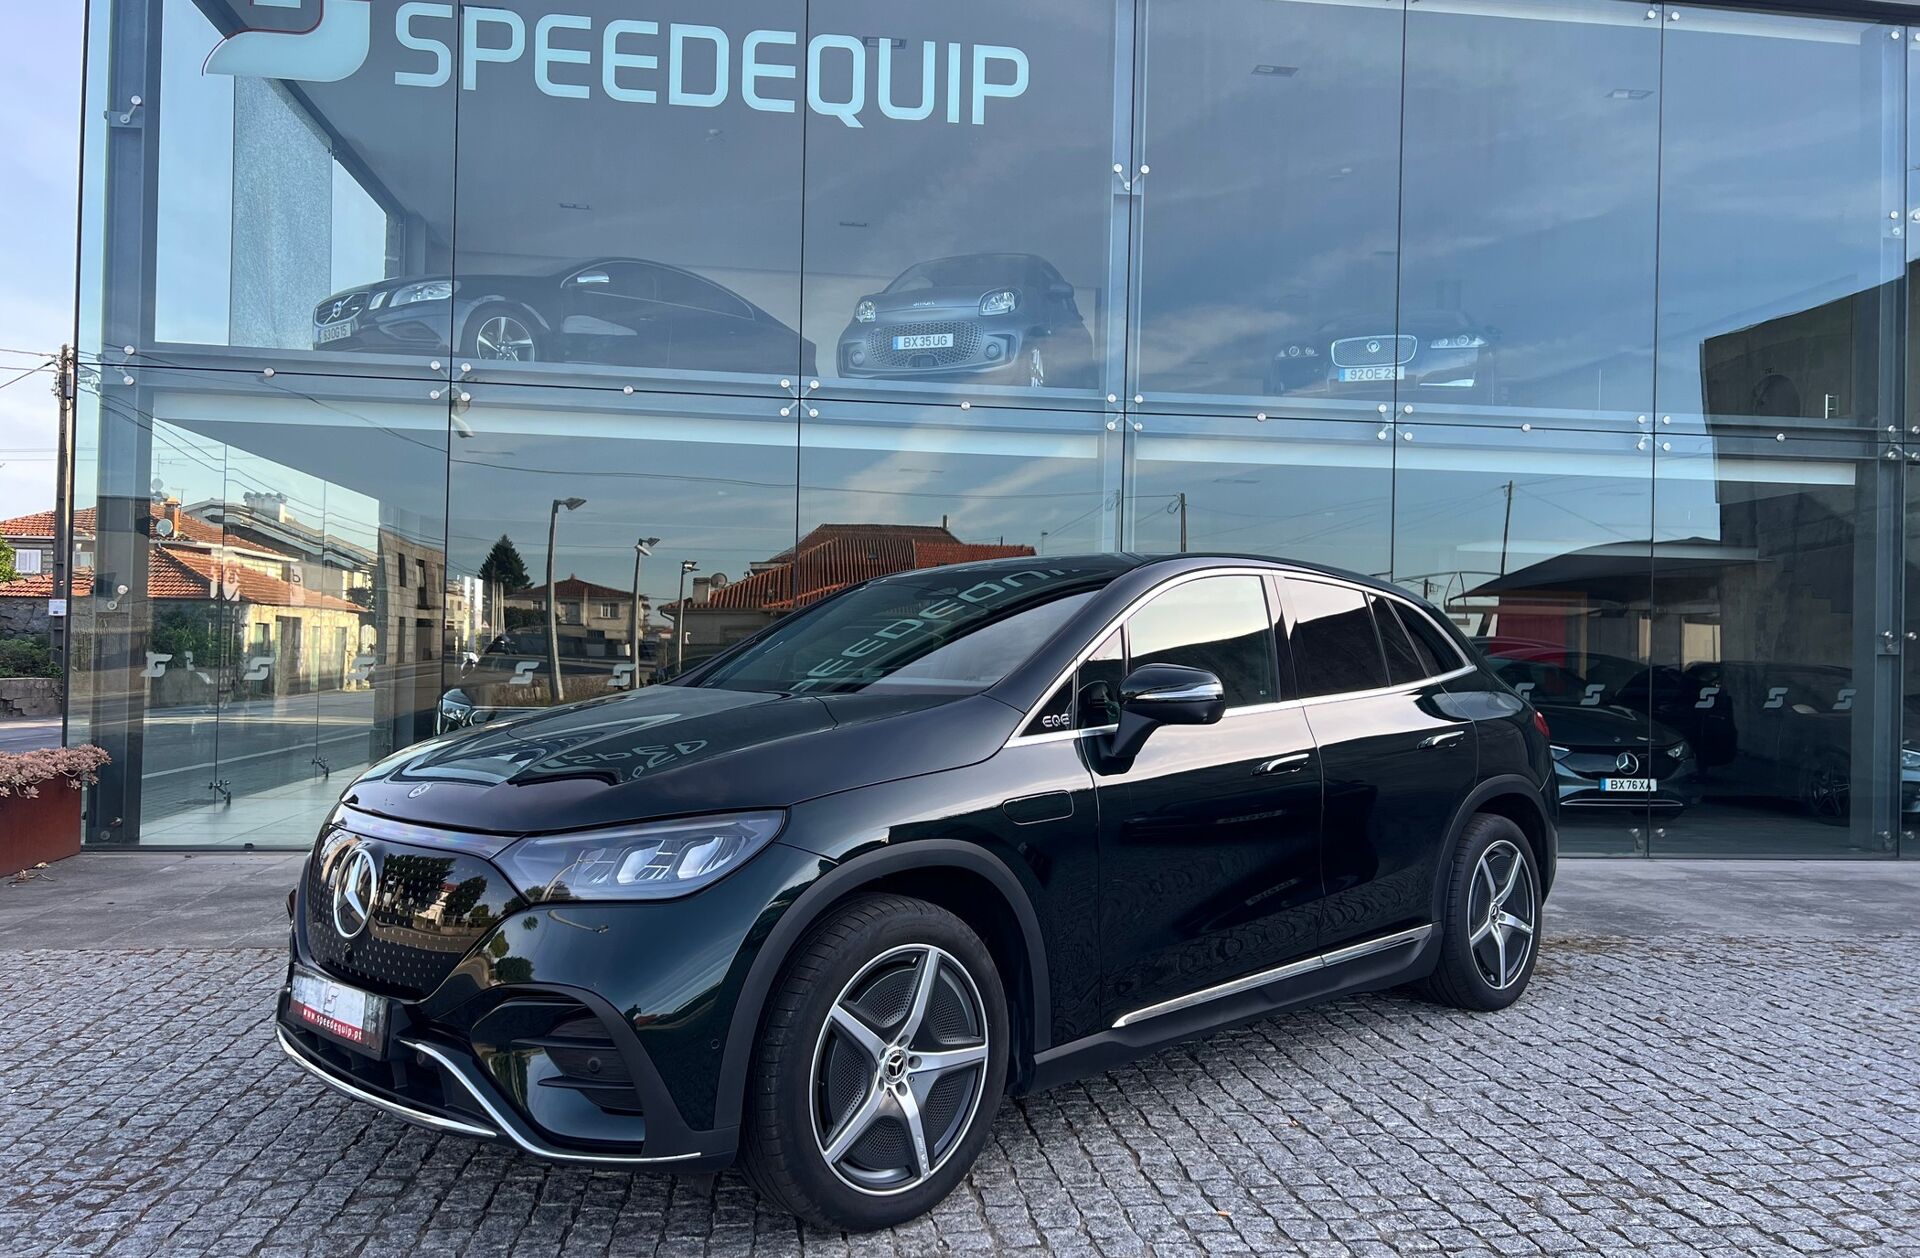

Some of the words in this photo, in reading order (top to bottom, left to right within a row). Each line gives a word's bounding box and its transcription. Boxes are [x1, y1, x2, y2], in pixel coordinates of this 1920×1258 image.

[394, 2, 1030, 128] SPEEDEQUIP
[1042, 713, 1070, 728] EQE
[303, 1007, 363, 1041] www.speedequip.pt
